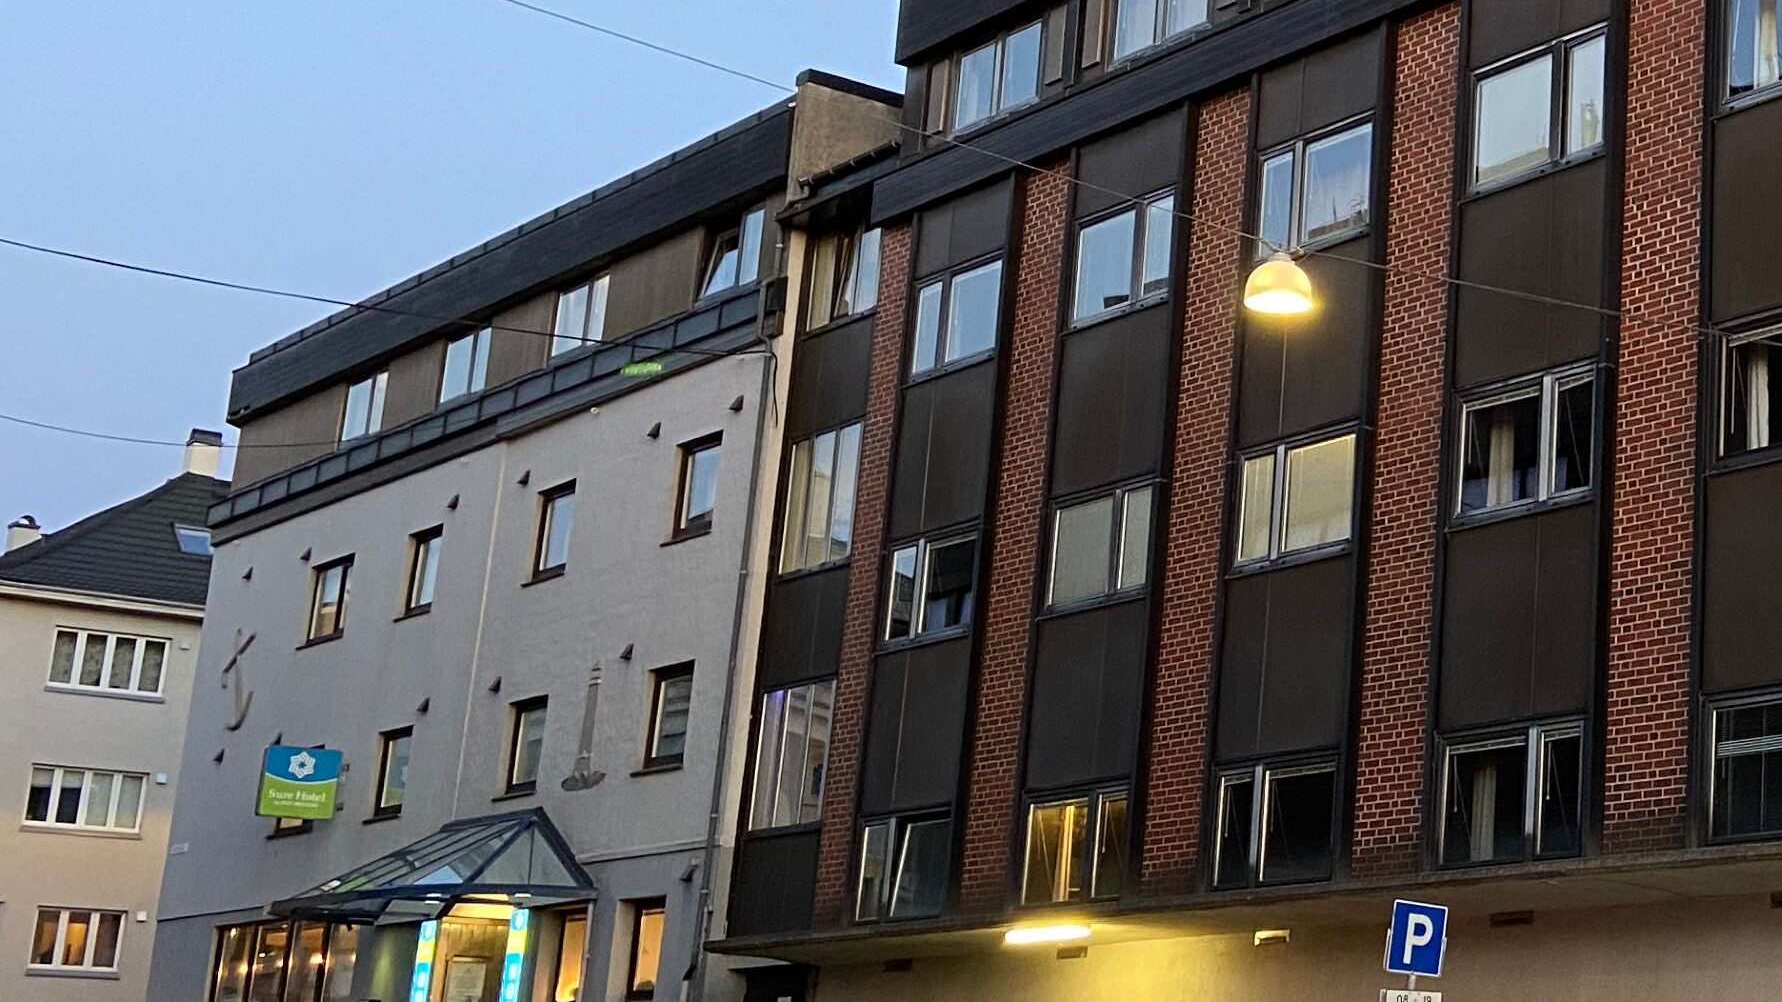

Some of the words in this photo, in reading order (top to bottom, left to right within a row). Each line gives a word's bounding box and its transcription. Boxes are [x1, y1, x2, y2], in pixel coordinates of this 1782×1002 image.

[268, 788, 294, 800] Sure
[296, 790, 326, 802] Hotel
[1403, 912, 1434, 965] P
